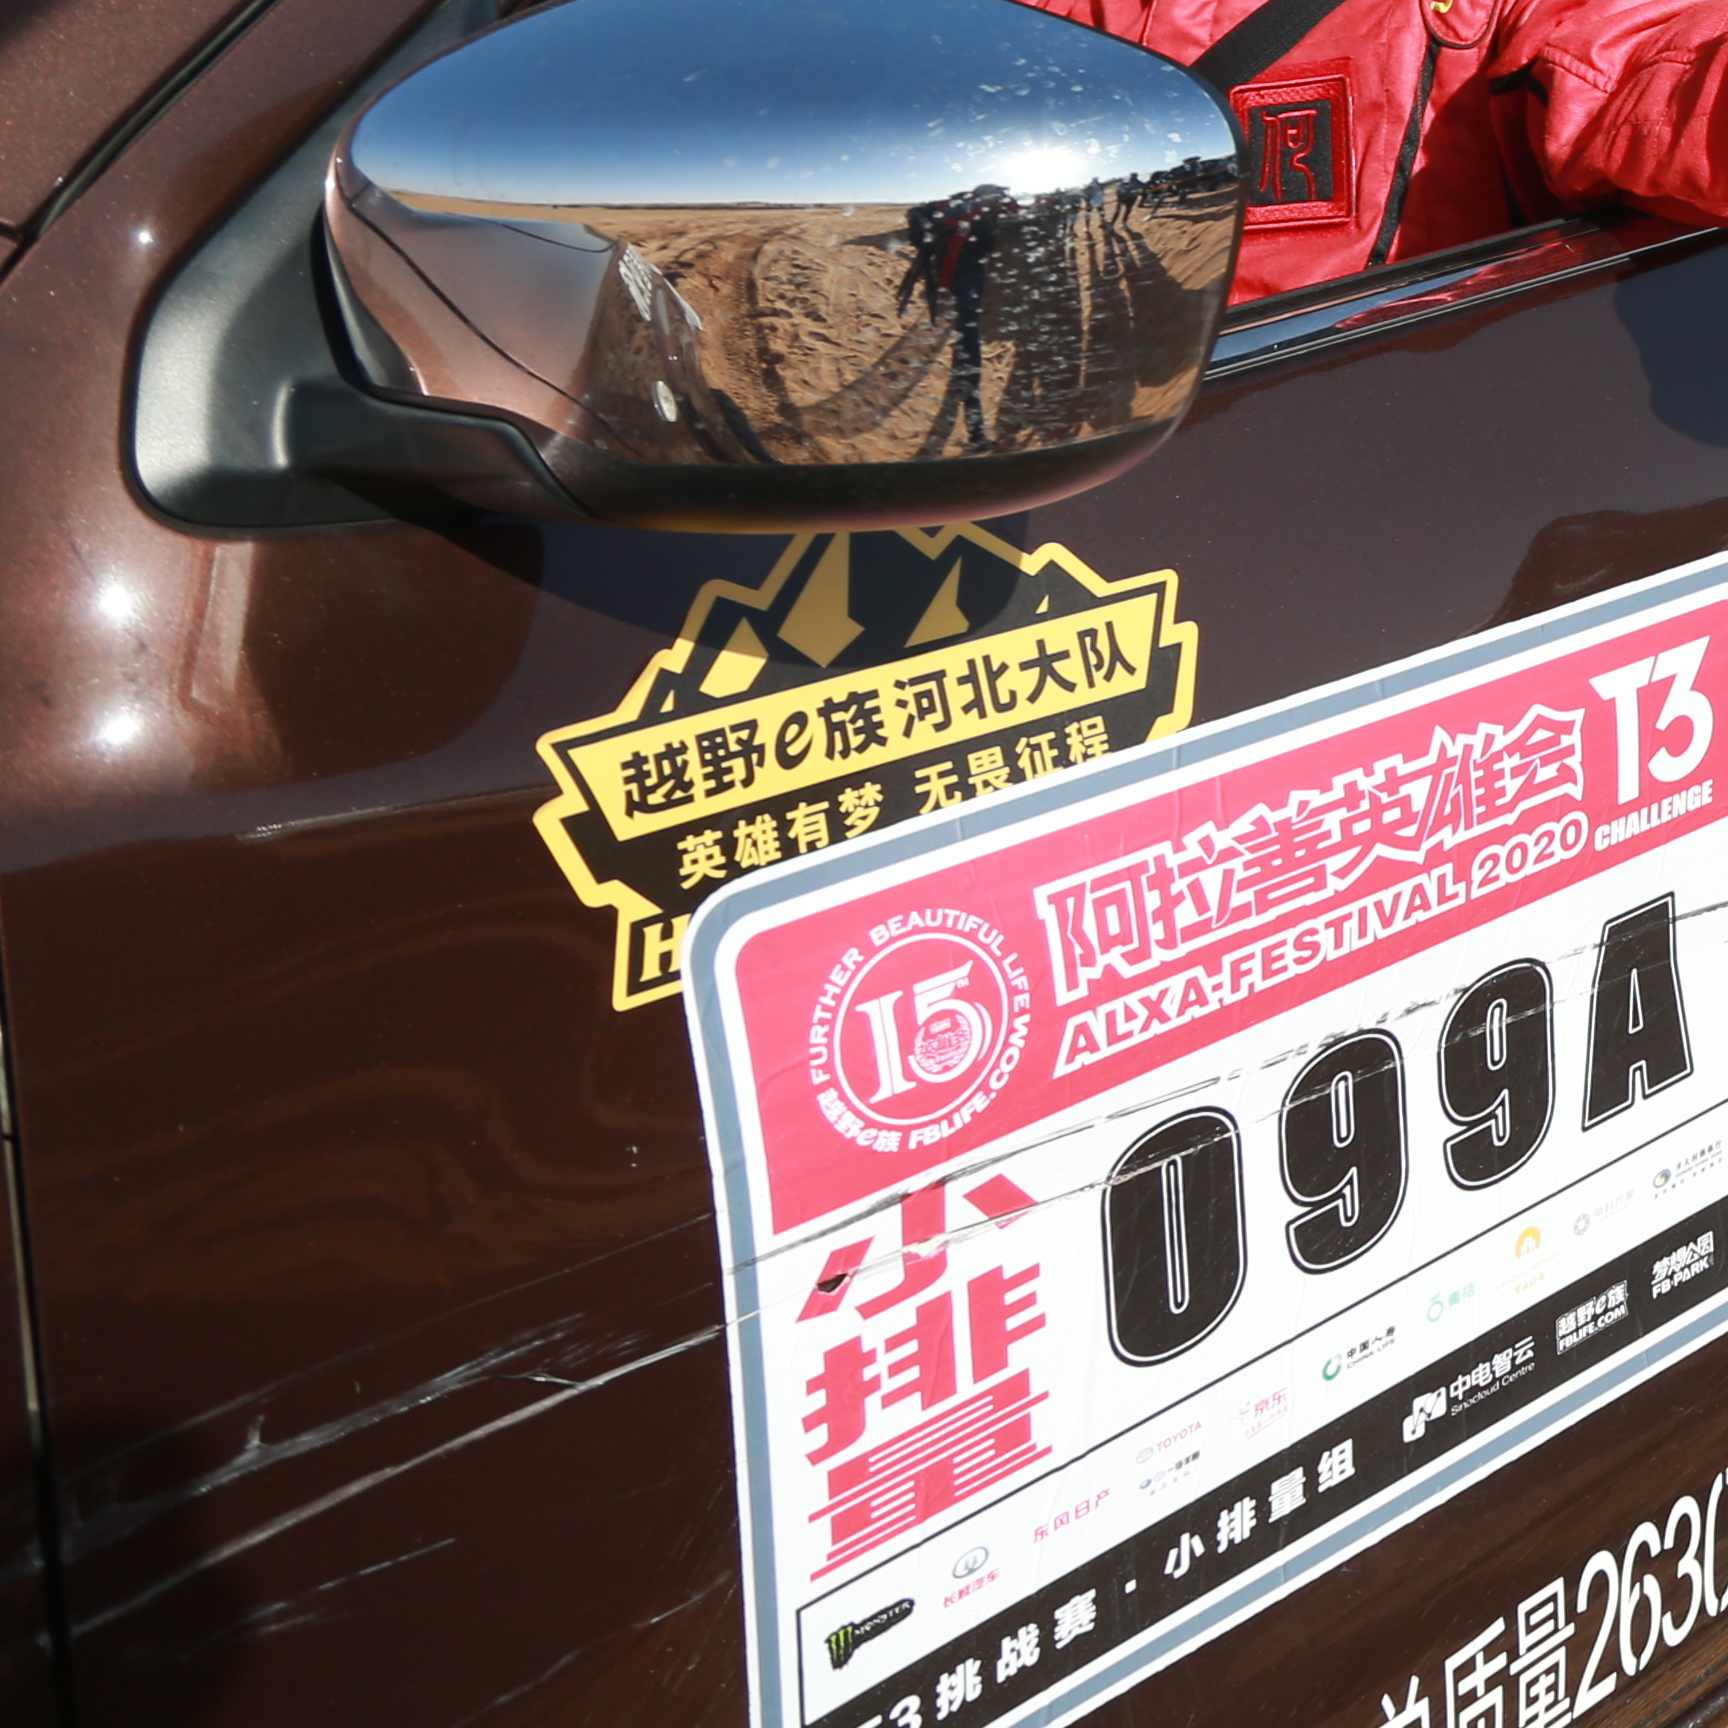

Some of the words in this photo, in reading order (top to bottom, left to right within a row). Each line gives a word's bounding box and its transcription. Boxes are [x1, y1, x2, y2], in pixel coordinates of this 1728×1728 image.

[620, 619, 1139, 819] 越野e族河北大队
[1588, 635, 1715, 806] T3
[676, 783, 885, 889] 英雄有梦
[914, 713, 1112, 816] 无畏征程
[1034, 703, 1587, 1006] 阿拉善英雄会
[1469, 810, 1590, 903] 2020
[1593, 780, 1714, 852] CHALLENGE
[809, 946, 864, 1085] FURTHER
[869, 907, 1008, 957] BEAUTIFUL
[1001, 952, 1031, 1010] LIFE
[908, 1014, 1031, 1151] FBLIFE.COM
[1100, 890, 1694, 1368] 099A
[1557, 1282, 1628, 1339] 越野e族
[1651, 1230, 1715, 1286] 梦想公园
[795, 1172, 1053, 1583] 小排量
[1449, 1335, 1536, 1401] 中电智云
[1558, 1305, 1627, 1352] FBLIFE.COM
[1155, 1420, 1203, 1453] TOYOTA
[1450, 1381, 1501, 1417] Sinocloud
[1500, 1361, 1536, 1388] Centre
